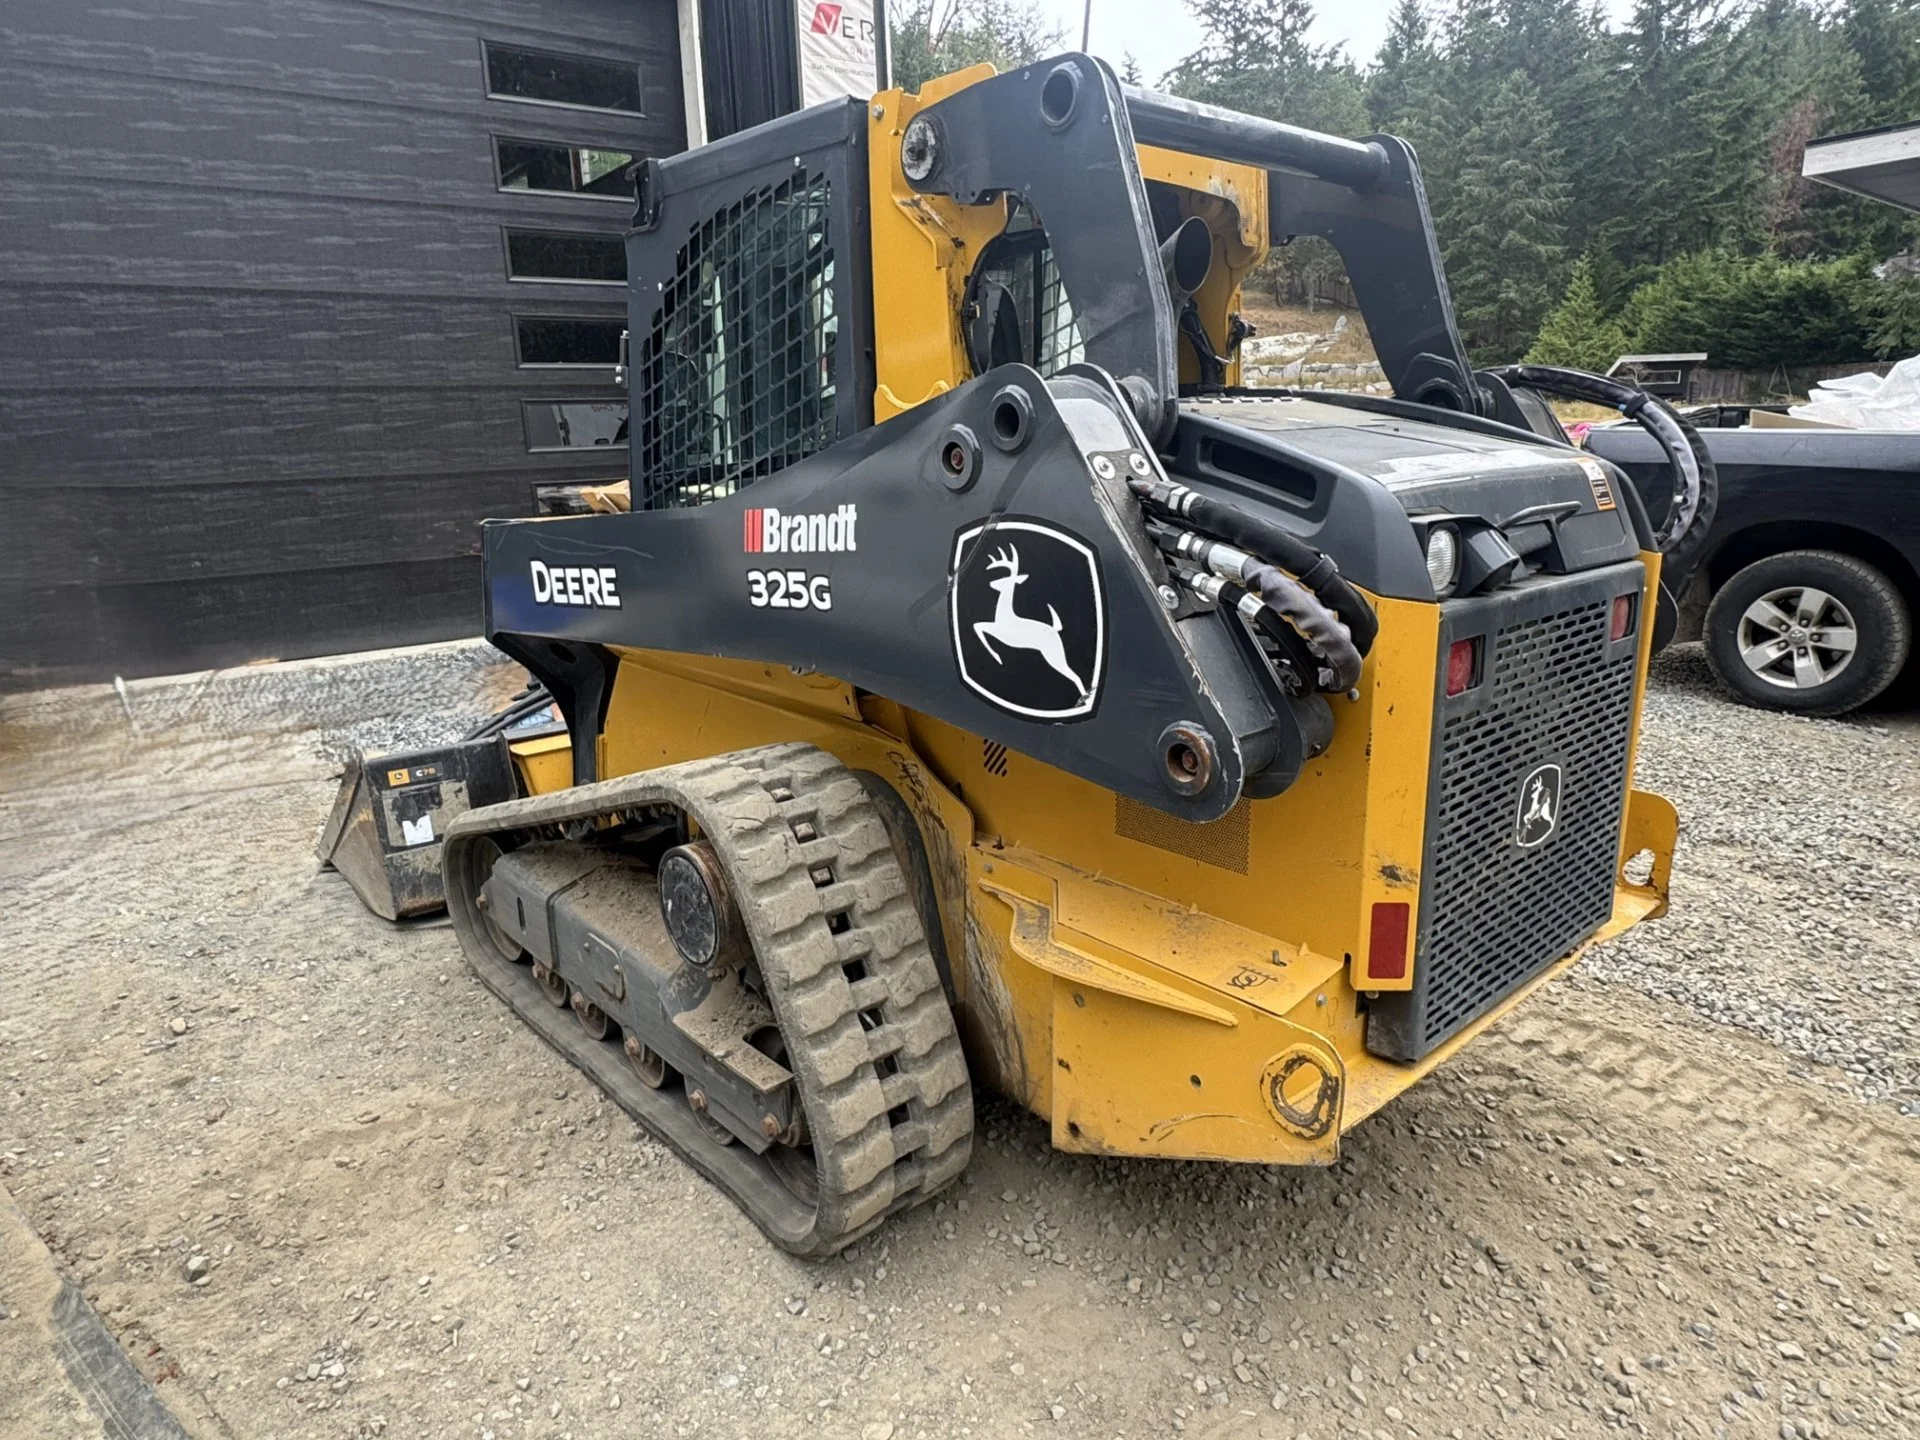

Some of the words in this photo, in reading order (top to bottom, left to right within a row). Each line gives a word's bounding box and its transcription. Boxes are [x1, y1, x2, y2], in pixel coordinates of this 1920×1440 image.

[762, 504, 857, 553] Brandt
[530, 560, 621, 607] DEERE
[747, 570, 832, 611] 325G
